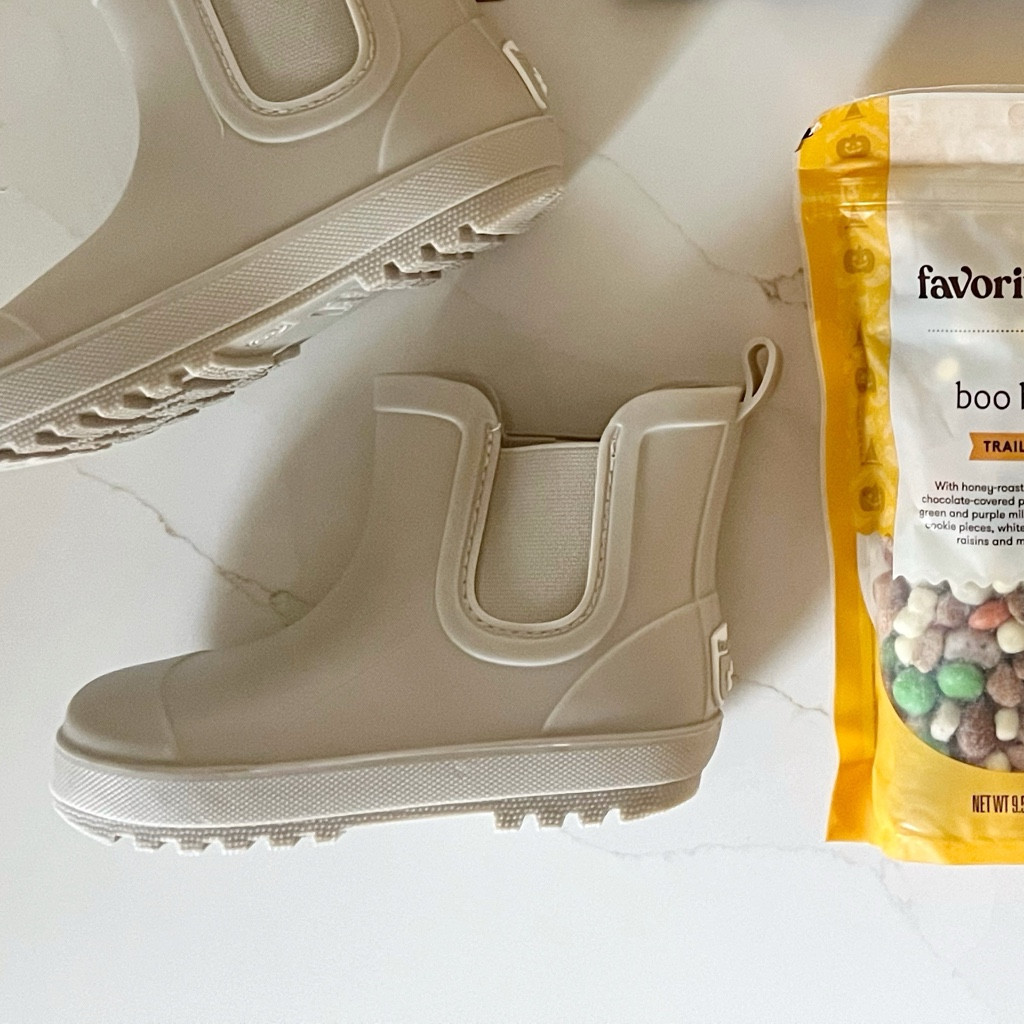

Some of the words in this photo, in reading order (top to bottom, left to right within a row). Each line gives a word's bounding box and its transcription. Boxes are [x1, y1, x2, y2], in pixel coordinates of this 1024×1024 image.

[955, 381, 1011, 410] boo
[935, 481, 959, 492] With
[921, 495, 1015, 507] chocolate-covered
[919, 509, 947, 519] green
[949, 509, 969, 519] and
[972, 510, 1006, 522] purple
[959, 522, 995, 535] pieces,
[956, 535, 989, 546] raisins
[992, 535, 1013, 546] and
[972, 795, 991, 813] NET
[993, 795, 1011, 813] WT
